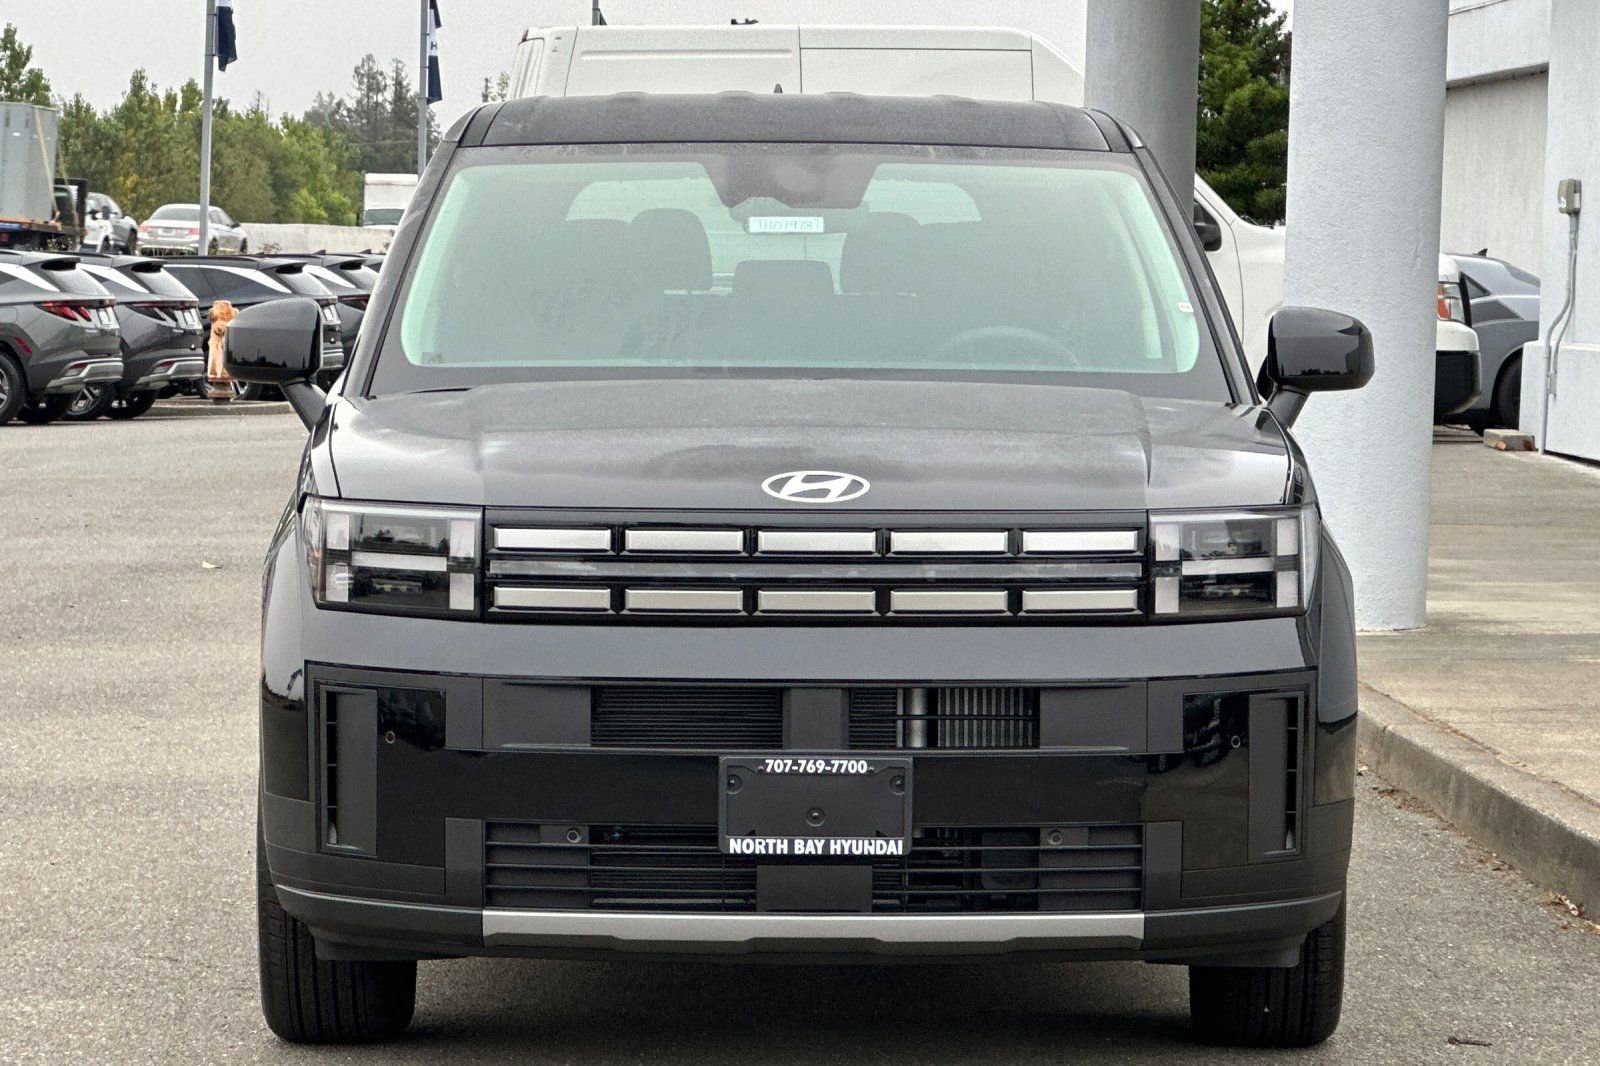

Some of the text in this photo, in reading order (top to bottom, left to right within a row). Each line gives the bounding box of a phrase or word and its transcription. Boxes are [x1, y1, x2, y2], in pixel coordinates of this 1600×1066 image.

[765, 759, 868, 774] 707-769-7700
[729, 838, 903, 855] NORTH BAY HYUNDAI
